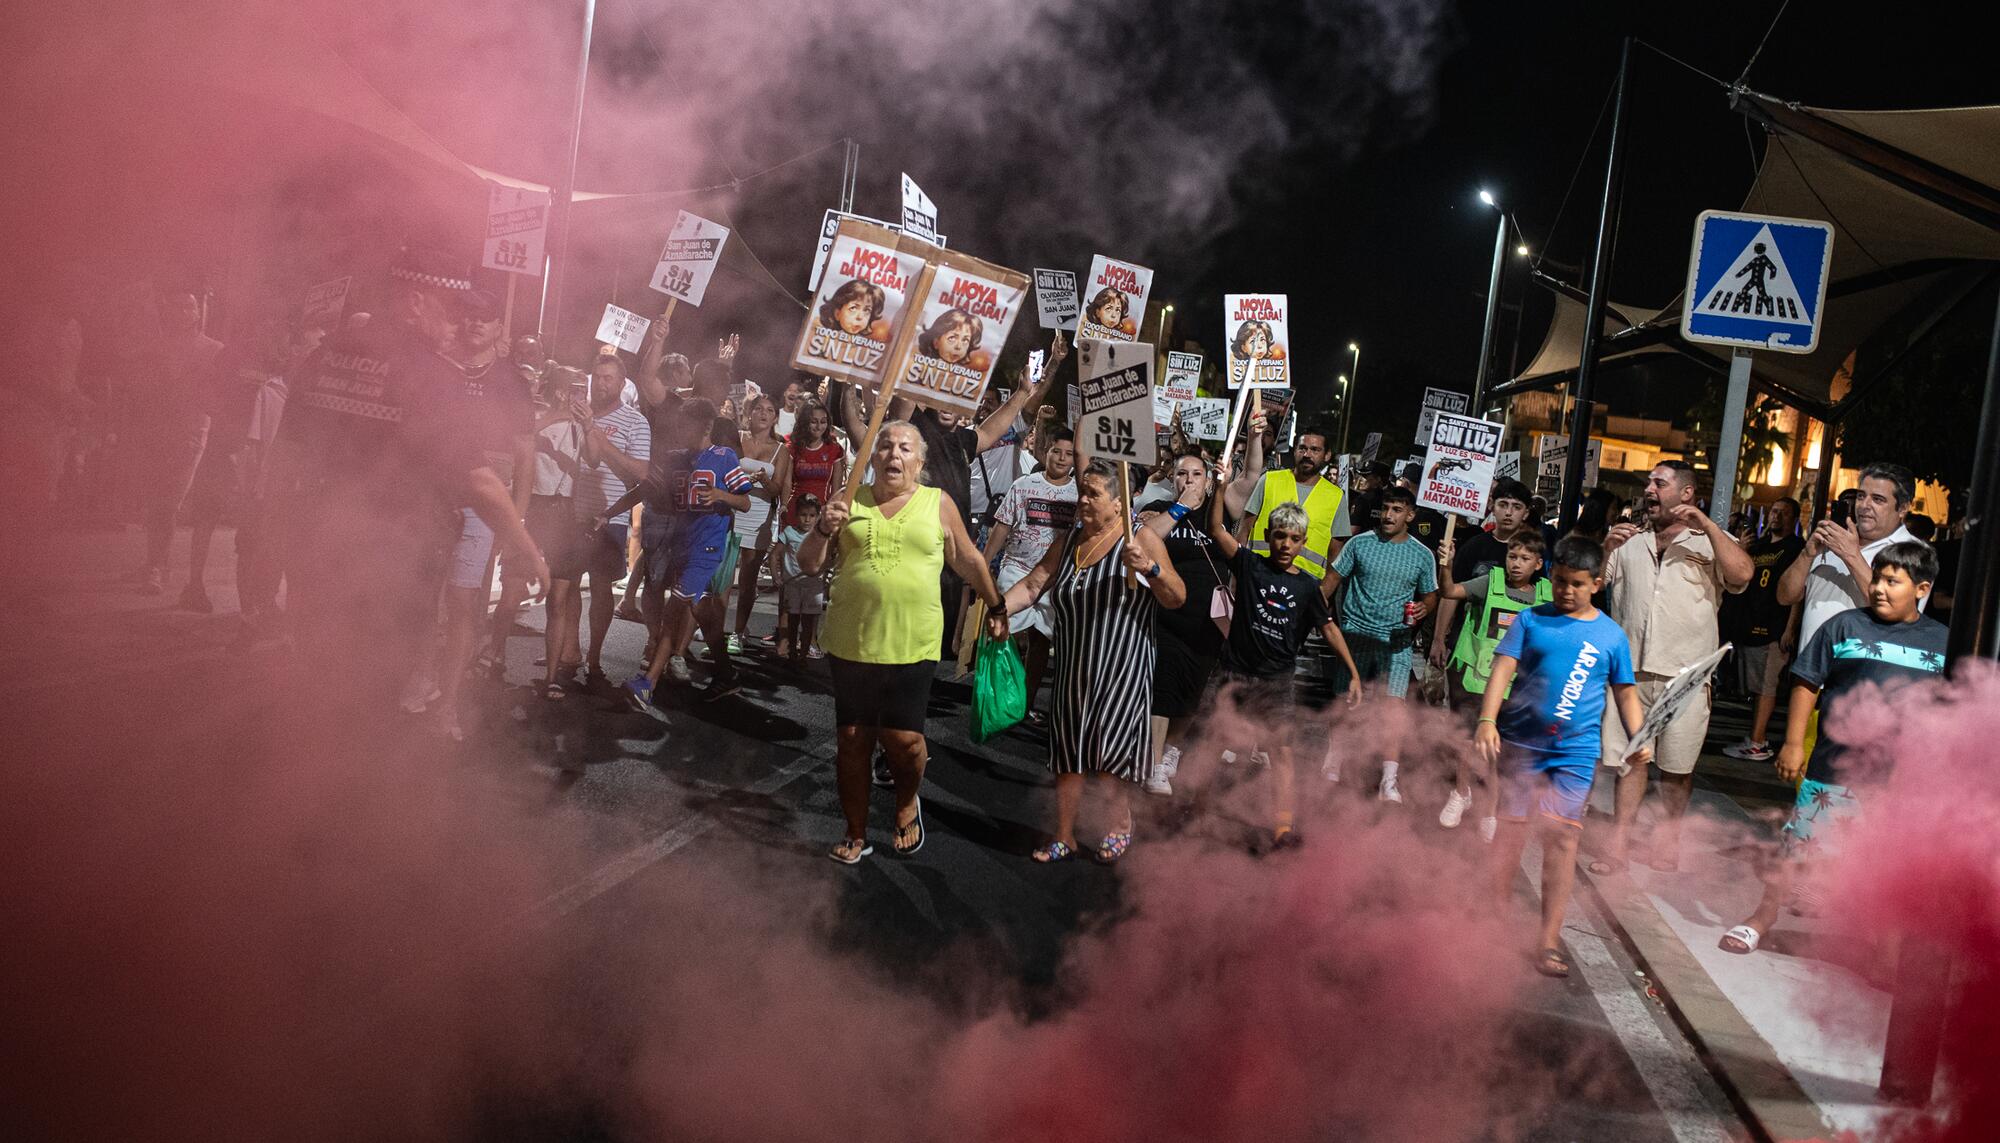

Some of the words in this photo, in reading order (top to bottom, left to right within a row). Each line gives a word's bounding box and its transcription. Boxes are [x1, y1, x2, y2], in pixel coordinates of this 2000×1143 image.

[664, 249, 713, 261] Aznalfarache
[667, 240, 682, 250] San
[683, 240, 701, 250] Juan
[701, 239, 711, 249] de
[494, 251, 528, 269] LUZ
[853, 247, 898, 276] MOYA
[668, 264, 695, 284] SIN
[857, 269, 871, 284] LA
[873, 270, 909, 294] CARA!
[1038, 275, 1055, 289] SIN
[1055, 277, 1074, 291] LUZ
[1105, 264, 1137, 285] MOYA
[660, 275, 692, 297] LUZ
[953, 277, 998, 307] MOYA
[1040, 291, 1073, 299] OLVIDADOS
[1109, 277, 1119, 290] LA
[1120, 280, 1144, 299] CARA!
[616, 310, 627, 318] UN
[955, 296, 970, 313] LA
[971, 301, 1008, 325] CARA!
[1240, 298, 1274, 312] MOYA
[1246, 311, 1257, 321] LA
[1257, 308, 1282, 323] CARA!
[814, 327, 839, 340] TODO
[839, 333, 850, 343] EL
[851, 334, 886, 352] VERANO
[1084, 320, 1101, 331] TODO
[1109, 328, 1133, 342] VERANO
[807, 335, 840, 363] SIN
[842, 341, 883, 371] LUZ
[1169, 357, 1183, 369] SIN
[1183, 359, 1200, 371] LUZ
[913, 353, 938, 367] TODO
[938, 360, 948, 370] EL
[949, 361, 983, 379] VERANO
[1258, 366, 1285, 382] LUZ
[906, 363, 938, 389] SIN
[942, 370, 981, 399] LUZ
[1081, 382, 1101, 397] San
[1102, 375, 1125, 392] Juan
[1125, 369, 1139, 383] de
[1084, 382, 1148, 413] Aznalfarache
[1427, 394, 1445, 409] SIN
[1445, 397, 1465, 412] LUZ
[1098, 415, 1133, 437] SIN
[1448, 418, 1468, 429] SANTA
[1468, 423, 1490, 433] ISABEL
[1095, 434, 1136, 457] LUZ
[1436, 423, 1463, 447] SIN
[1463, 429, 1497, 454] LUZ
[1434, 444, 1443, 453] LA
[1445, 446, 1457, 457] LUZ
[1459, 450, 1469, 458] ES
[1423, 491, 1482, 513] MATARNOS!
[1429, 481, 1463, 497] DEJAD
[1465, 490, 1480, 501] DE
[1760, 568, 1771, 588] 8
[1259, 584, 1297, 608] PARIS
